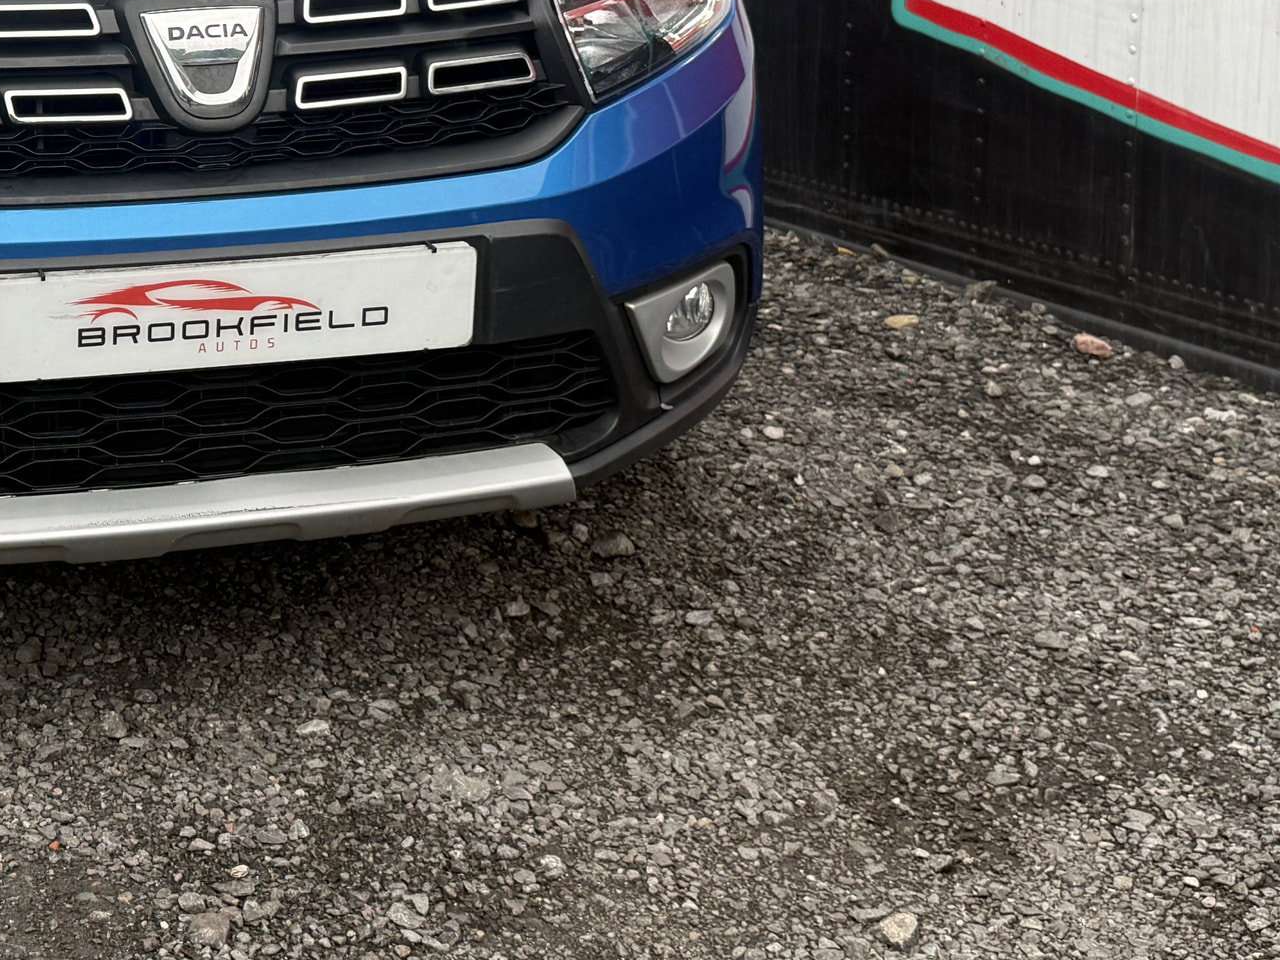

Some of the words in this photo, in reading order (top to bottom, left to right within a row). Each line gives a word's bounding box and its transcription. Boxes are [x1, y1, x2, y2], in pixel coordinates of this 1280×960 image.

[167, 23, 249, 41] DACIA
[77, 306, 389, 348] BROOKFIELD
[197, 337, 276, 354] AUTOS
